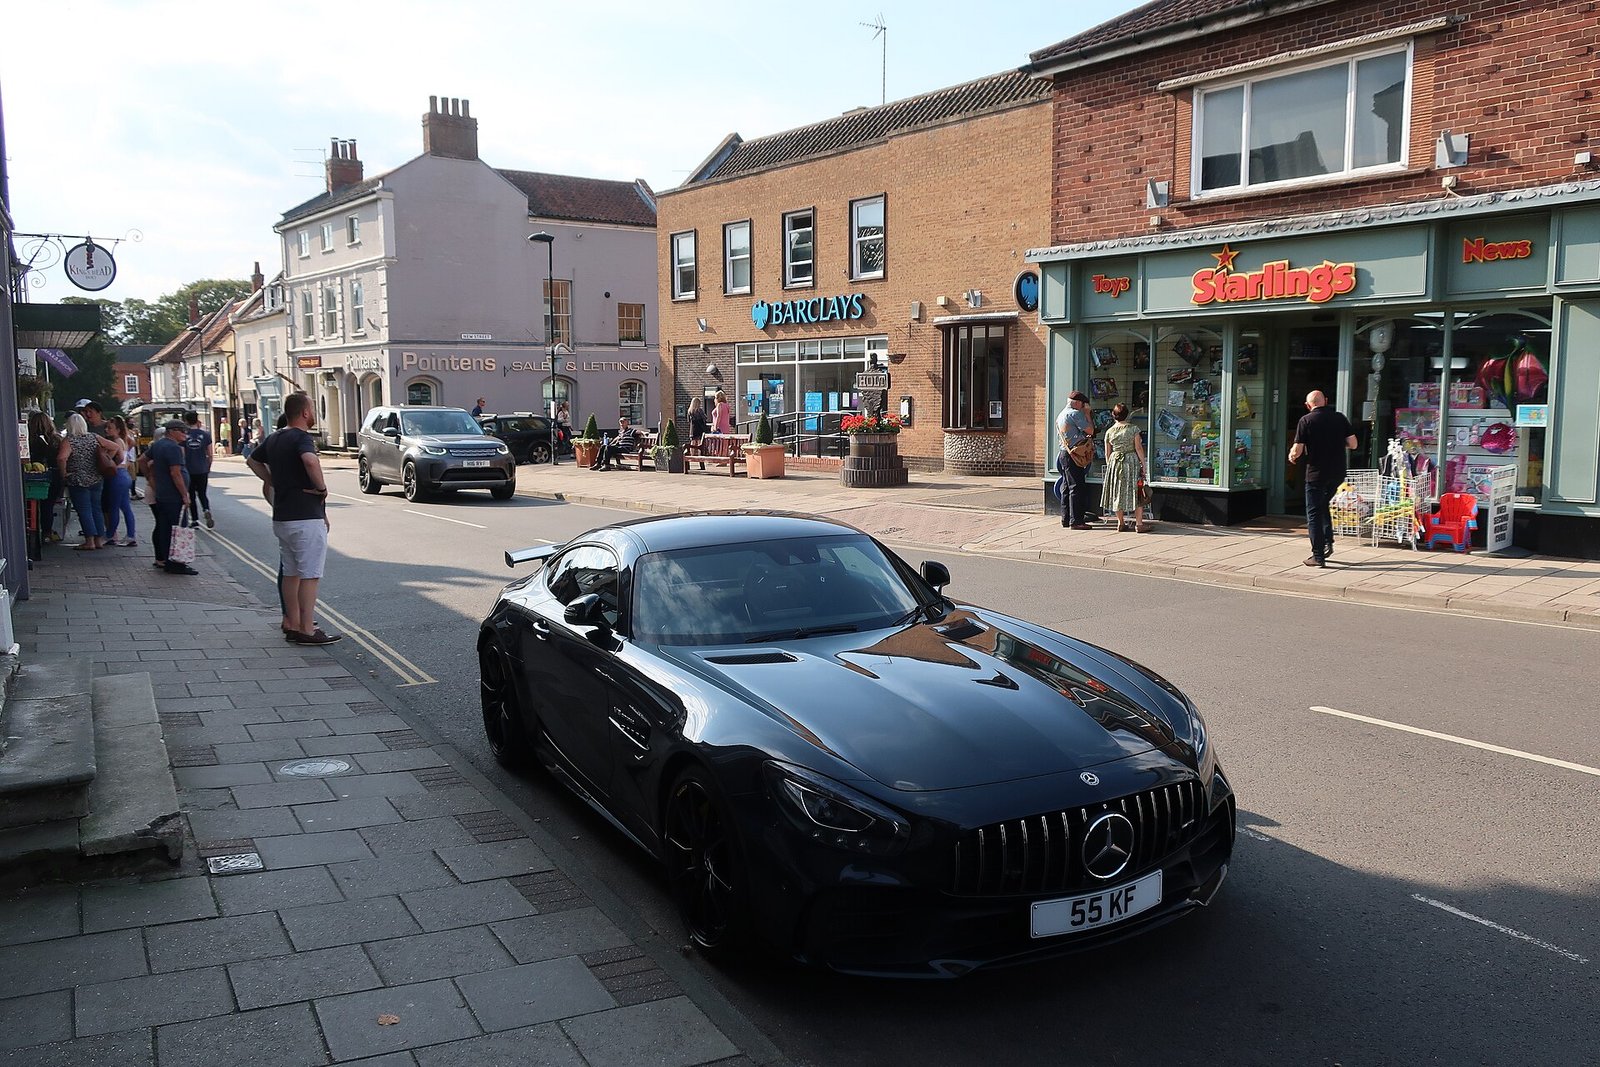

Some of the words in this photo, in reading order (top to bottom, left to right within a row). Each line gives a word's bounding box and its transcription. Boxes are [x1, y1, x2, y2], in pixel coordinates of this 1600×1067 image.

[1463, 238, 1531, 263] News
[1091, 274, 1130, 298] Toys
[1190, 259, 1357, 305] Starlings
[771, 293, 864, 325] BARCLAYS
[345, 354, 381, 370] Pointens
[402, 352, 496, 372] Pointens
[512, 361, 555, 371] SALE
[565, 362, 577, 371] &
[583, 361, 650, 372] LETTINGS
[858, 375, 886, 387] HOLT
[1070, 896, 1103, 927] 55
[1109, 885, 1137, 918] KF
